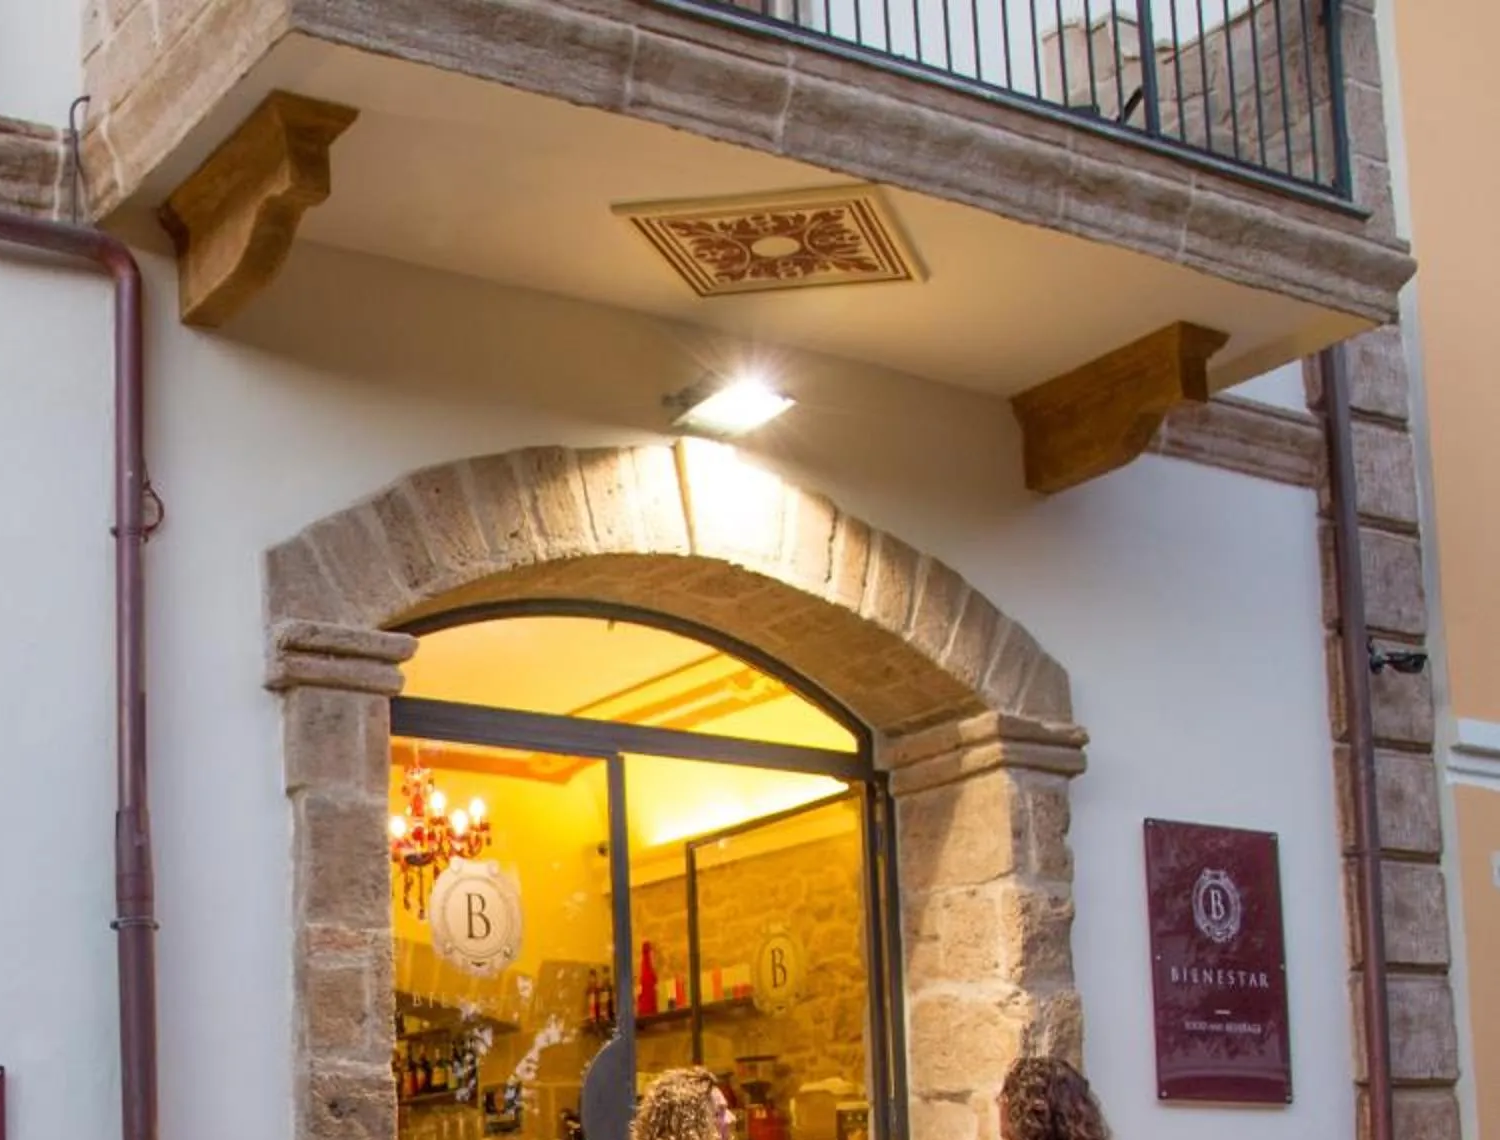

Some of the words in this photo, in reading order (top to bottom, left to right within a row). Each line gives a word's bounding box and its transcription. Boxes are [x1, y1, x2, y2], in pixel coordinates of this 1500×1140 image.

[466, 893, 491, 939] B
[1210, 889, 1225, 920] B
[771, 947, 787, 988] B
[1170, 966, 1269, 989] BIENESTAR
